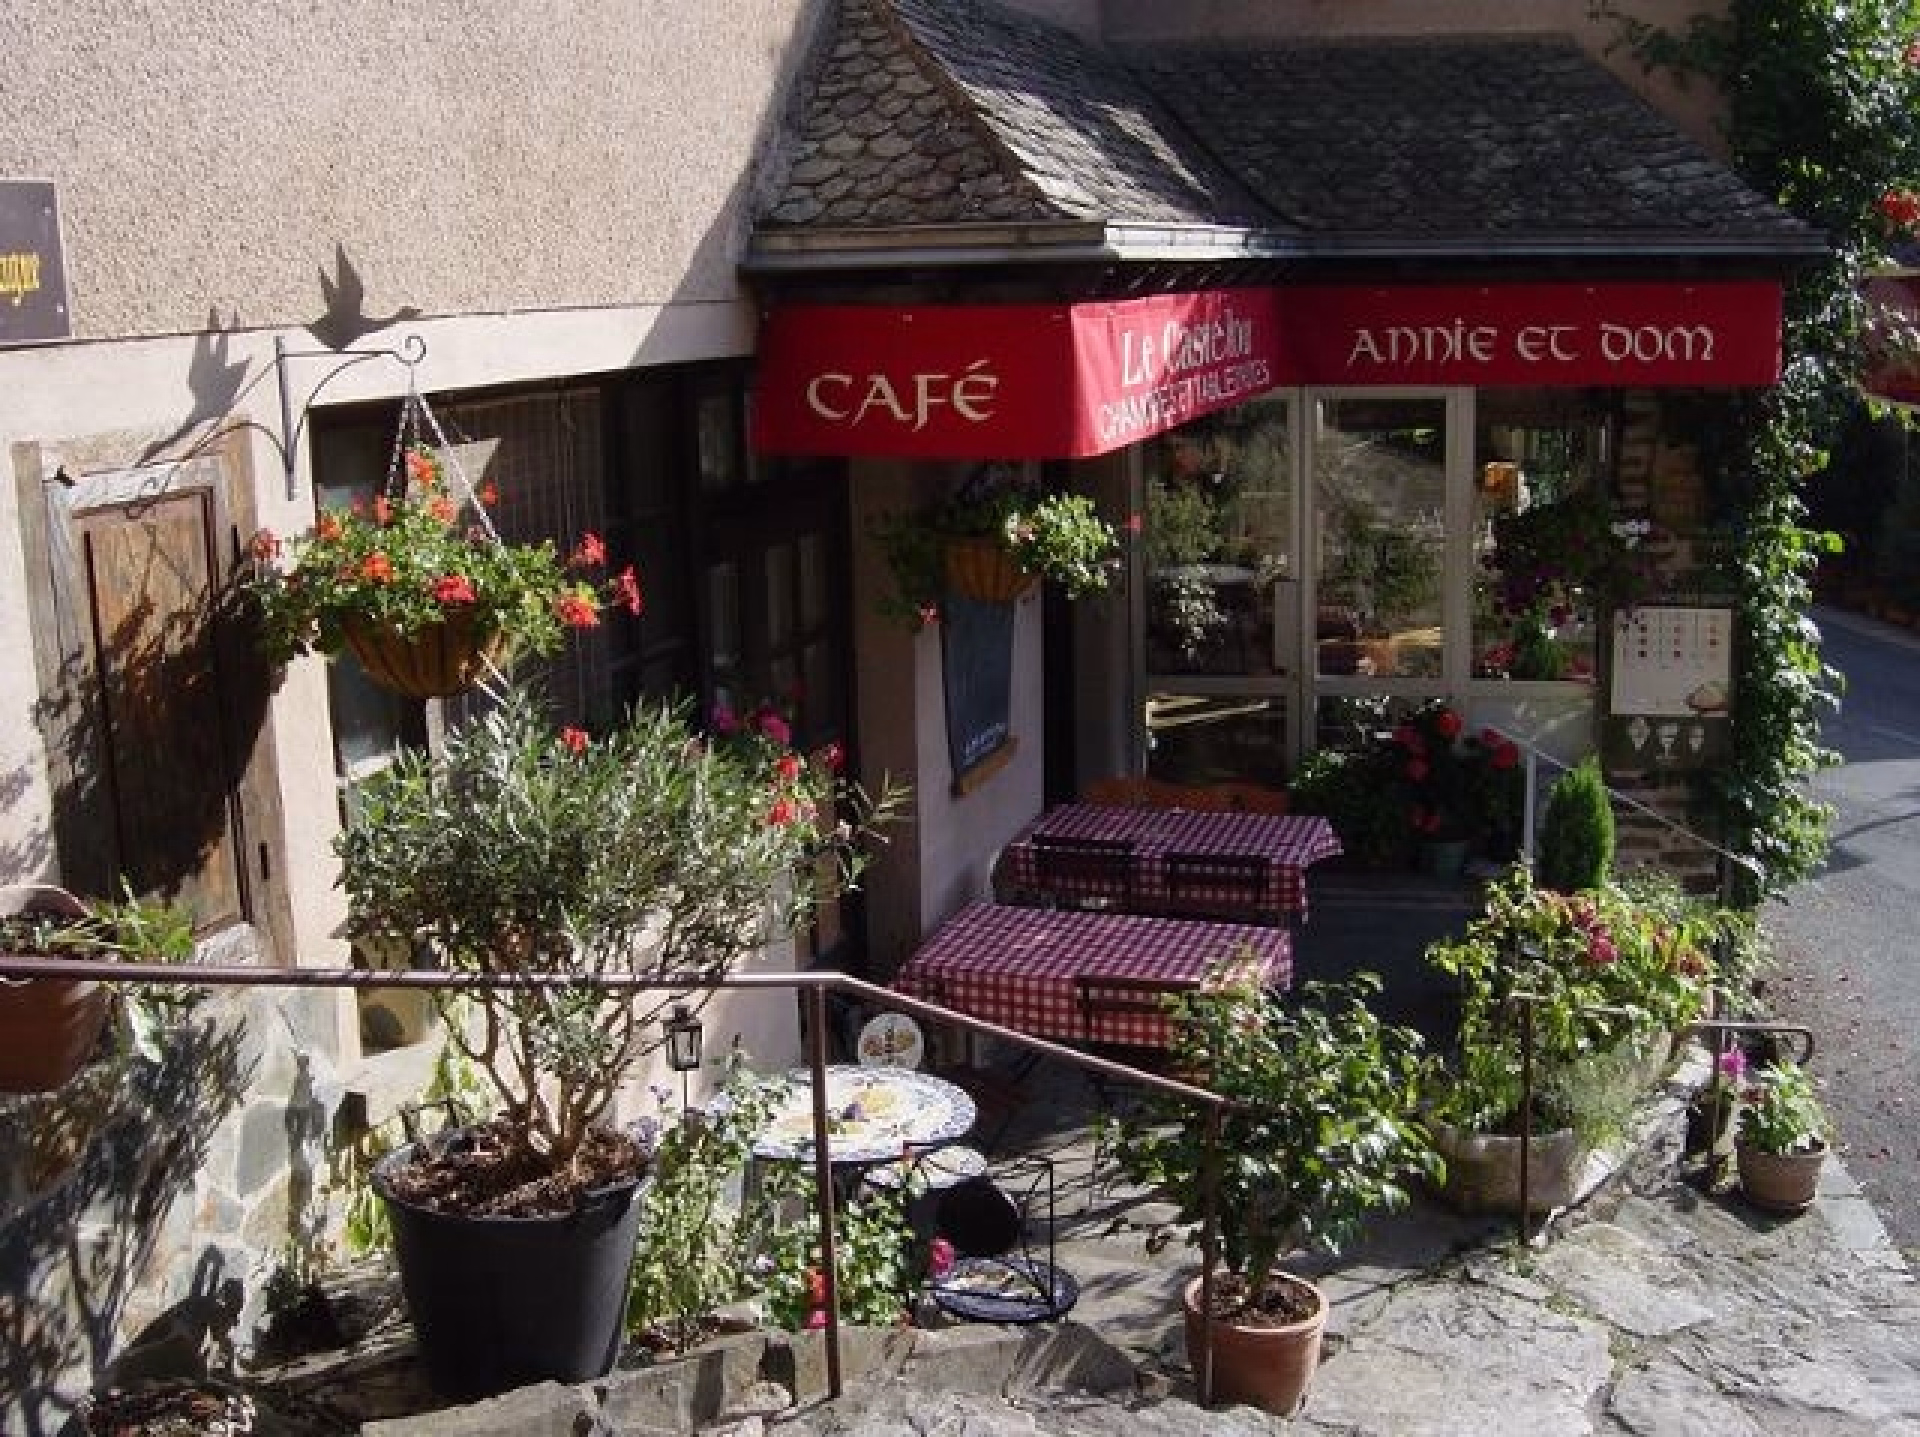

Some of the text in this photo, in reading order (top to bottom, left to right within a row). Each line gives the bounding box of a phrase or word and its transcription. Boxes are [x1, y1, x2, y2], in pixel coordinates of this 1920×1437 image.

[1121, 328, 1155, 388] Le
[1346, 317, 1715, 367] ANNIE ET DOM
[806, 359, 1000, 433] CAFÉ
